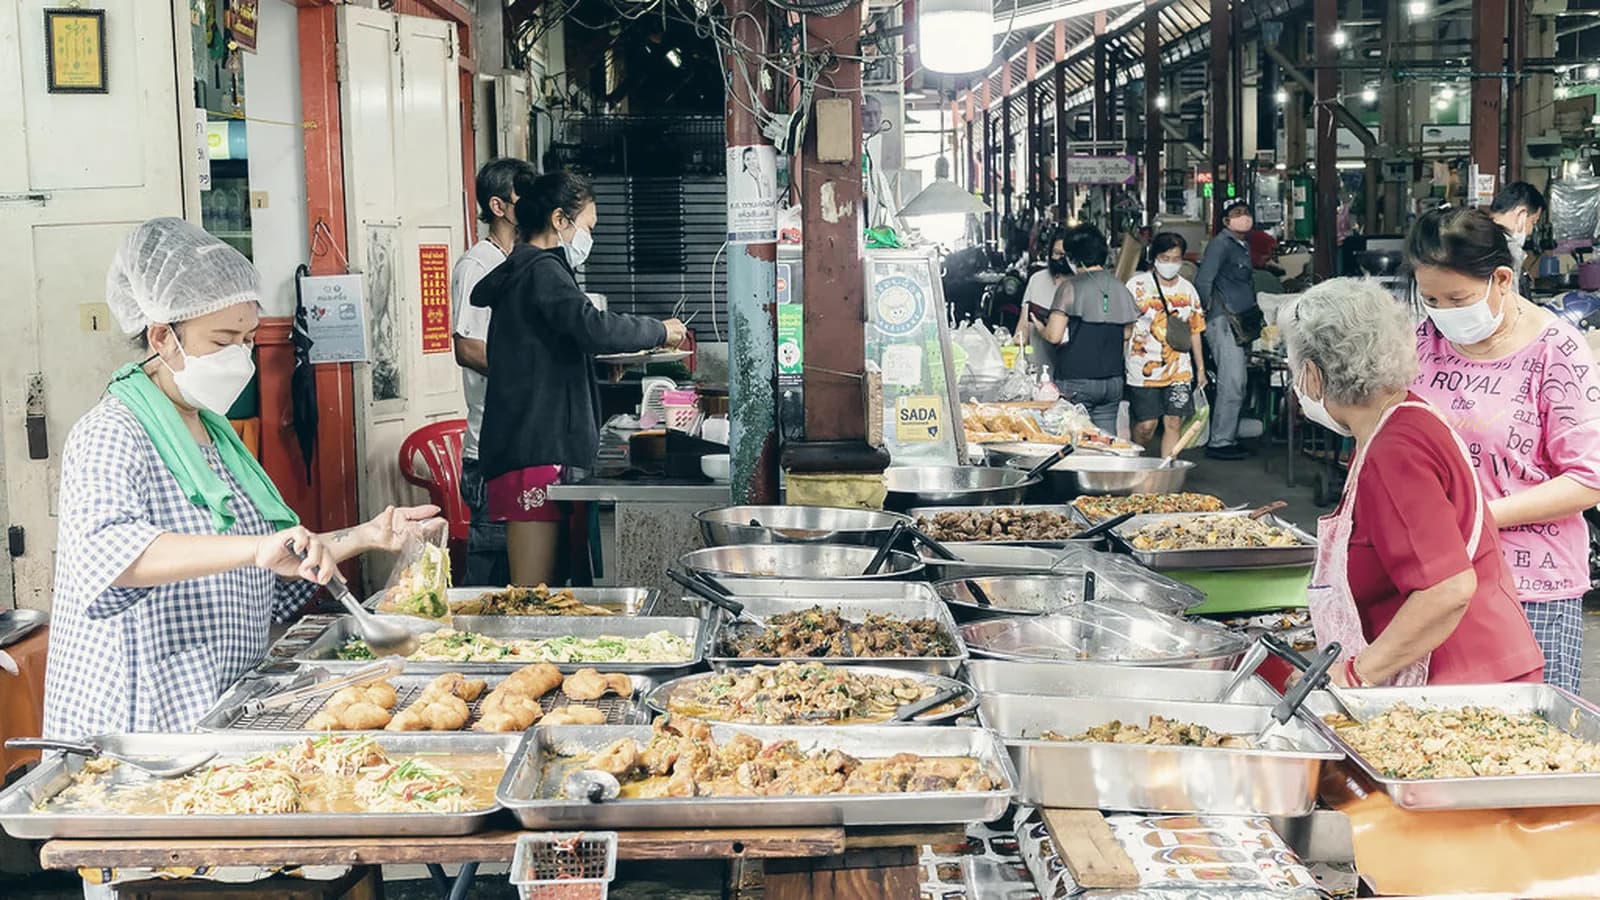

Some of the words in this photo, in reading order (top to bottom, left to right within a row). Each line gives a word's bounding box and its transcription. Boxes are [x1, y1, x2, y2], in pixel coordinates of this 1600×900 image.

[1430, 370, 1502, 396] ROYAL
[1451, 396, 1477, 411] the
[900, 408, 937, 421] SADA
[1506, 425, 1535, 456] be
